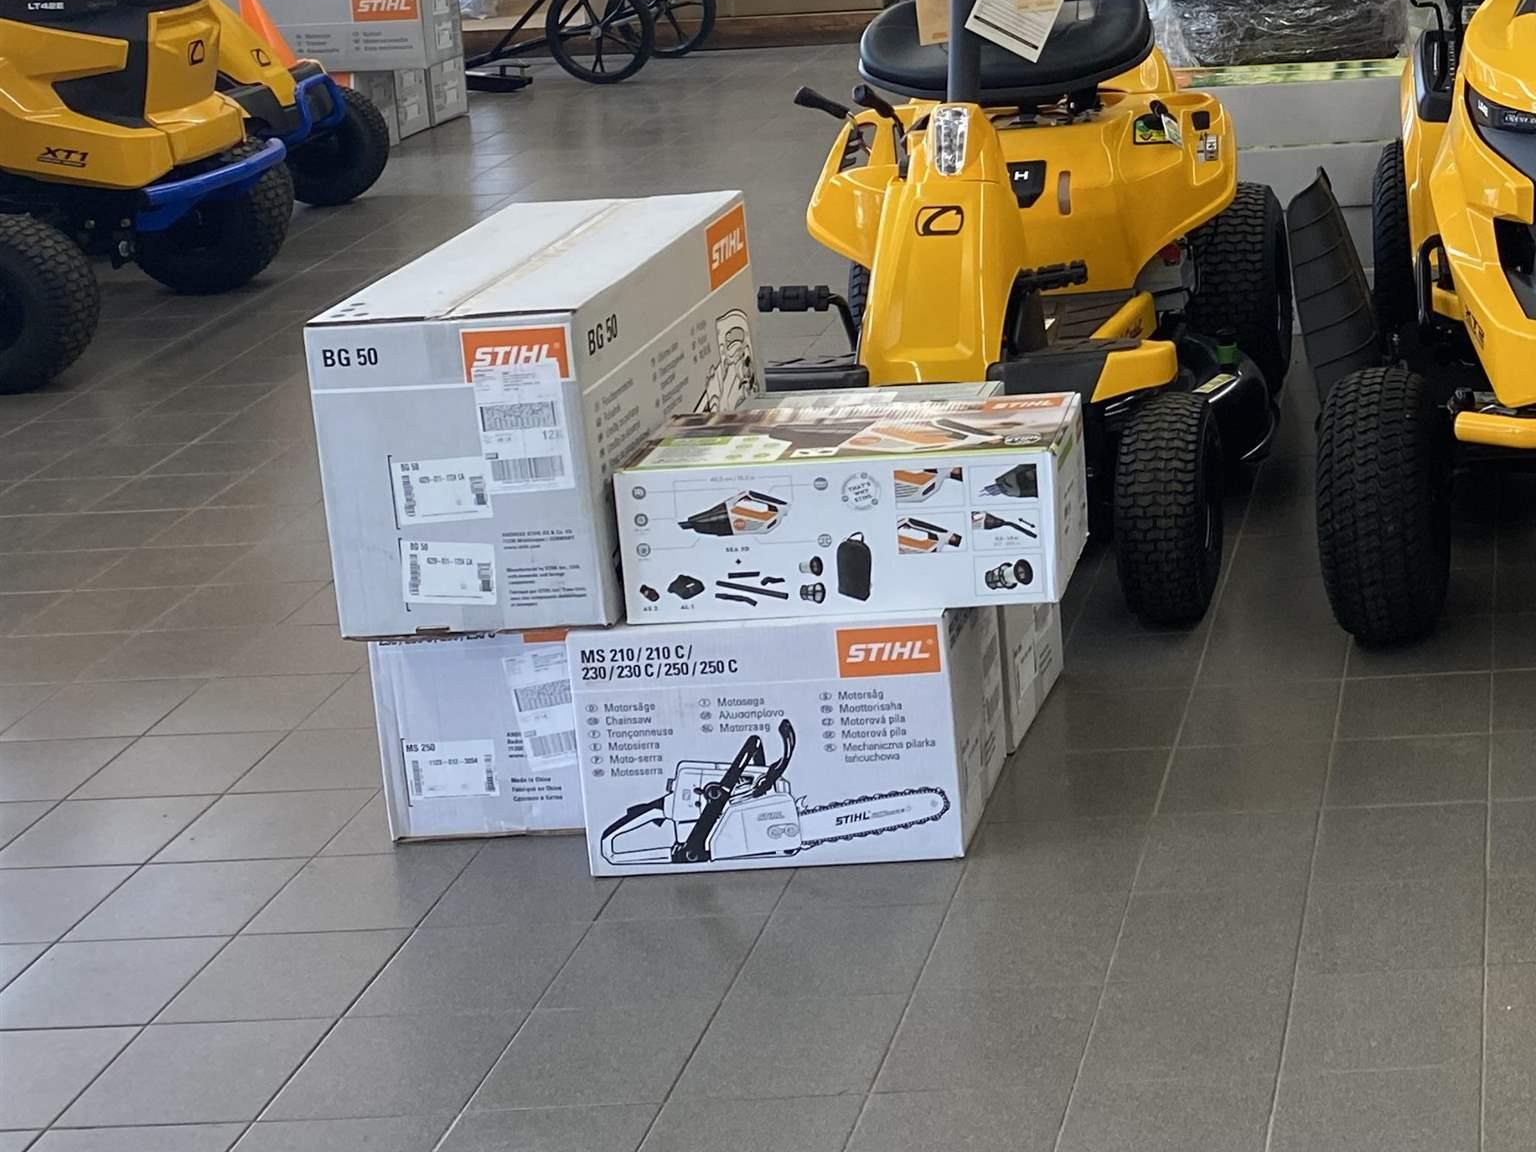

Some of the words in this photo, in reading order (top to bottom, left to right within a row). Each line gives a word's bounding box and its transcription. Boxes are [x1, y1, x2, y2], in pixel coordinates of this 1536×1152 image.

[711, 236, 744, 271] STIHL
[587, 322, 604, 357] BG
[605, 313, 618, 343] 50
[322, 348, 352, 368] BG
[356, 347, 379, 367] 50
[473, 344, 557, 367] STIHL
[992, 399, 1055, 410] STIHL
[580, 648, 605, 665] MS
[609, 647, 634, 663] 210
[646, 645, 670, 661] 210
[674, 645, 685, 659] C
[846, 641, 932, 663] STIHL
[581, 665, 607, 681] 230
[615, 664, 641, 679] 230
[644, 663, 655, 678] C
[663, 661, 690, 677] 250
[699, 660, 725, 676] 250
[728, 659, 739, 674] C
[716, 697, 765, 708] Motosega
[605, 715, 652, 726] Chainsaw
[719, 722, 771, 733] Motorzaag
[606, 728, 674, 740] Tronçonneuse
[405, 744, 419, 752] MS
[421, 743, 436, 752] 250
[608, 741, 661, 752] Motosierra
[609, 754, 663, 765] Moto-serra
[610, 767, 664, 777] Motosserra
[835, 811, 871, 826] STIHL
